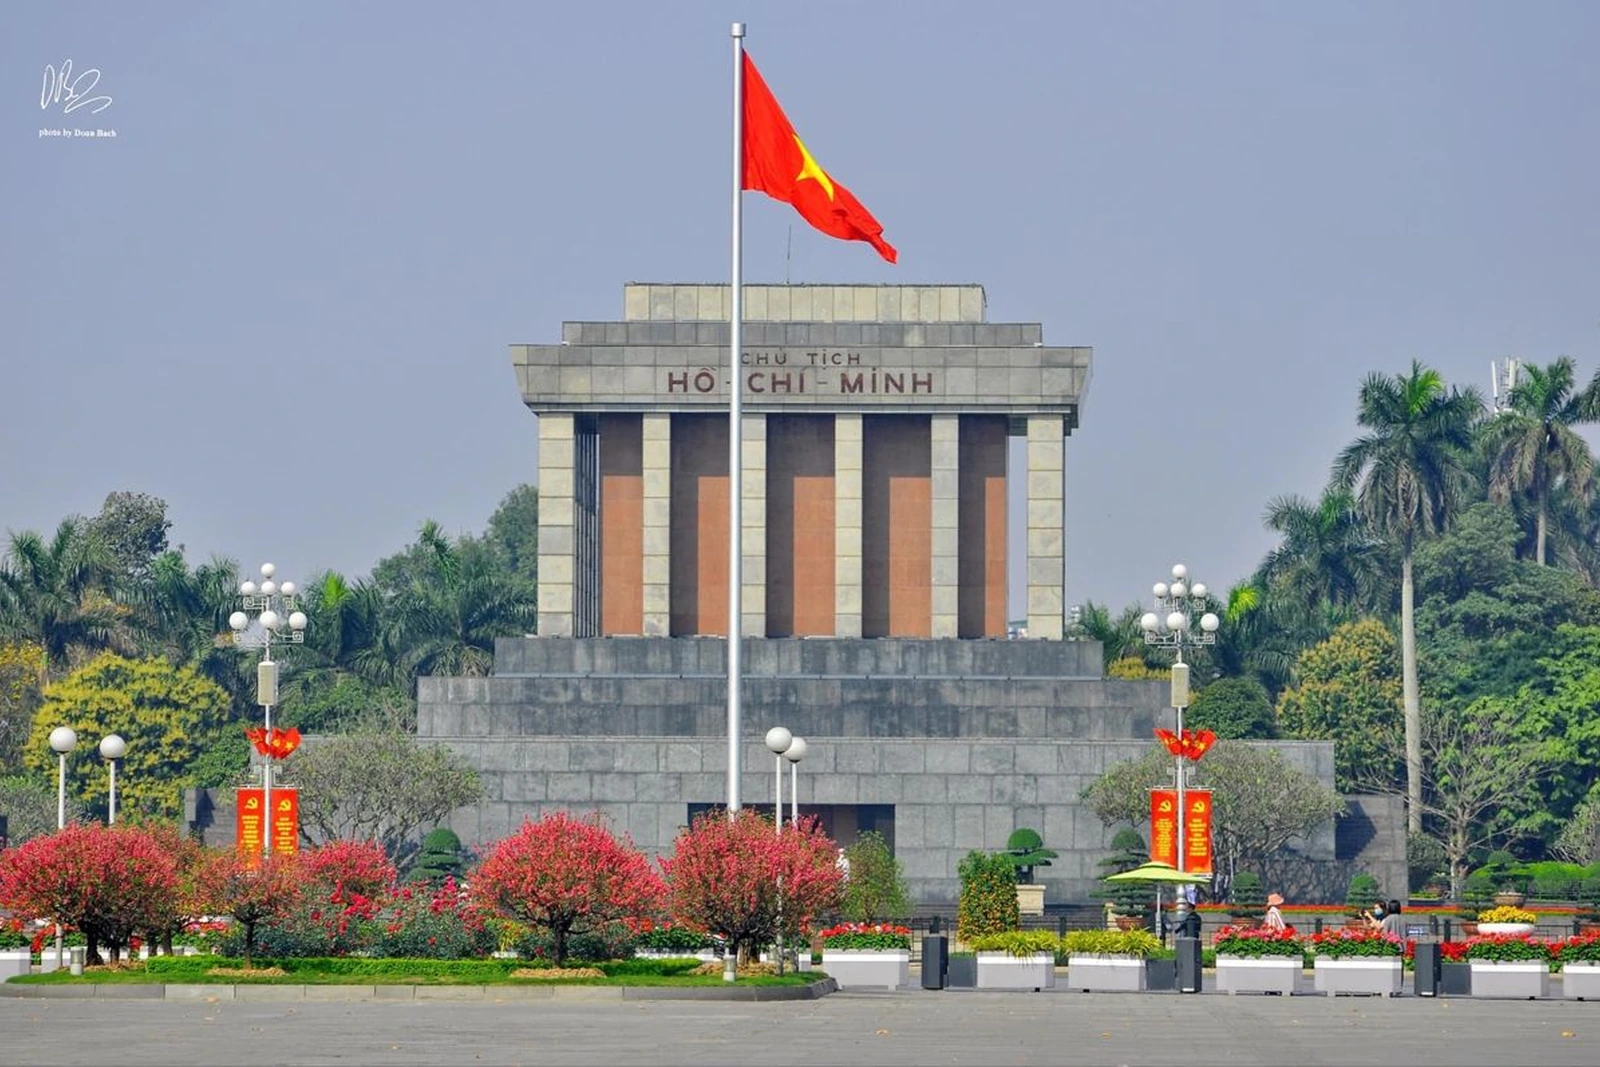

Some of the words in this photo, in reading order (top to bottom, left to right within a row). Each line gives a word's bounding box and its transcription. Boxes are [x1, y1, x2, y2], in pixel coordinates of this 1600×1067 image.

[668, 366, 716, 393] HỒ
[747, 366, 808, 393] CHÍ
[841, 367, 932, 393] MINH
